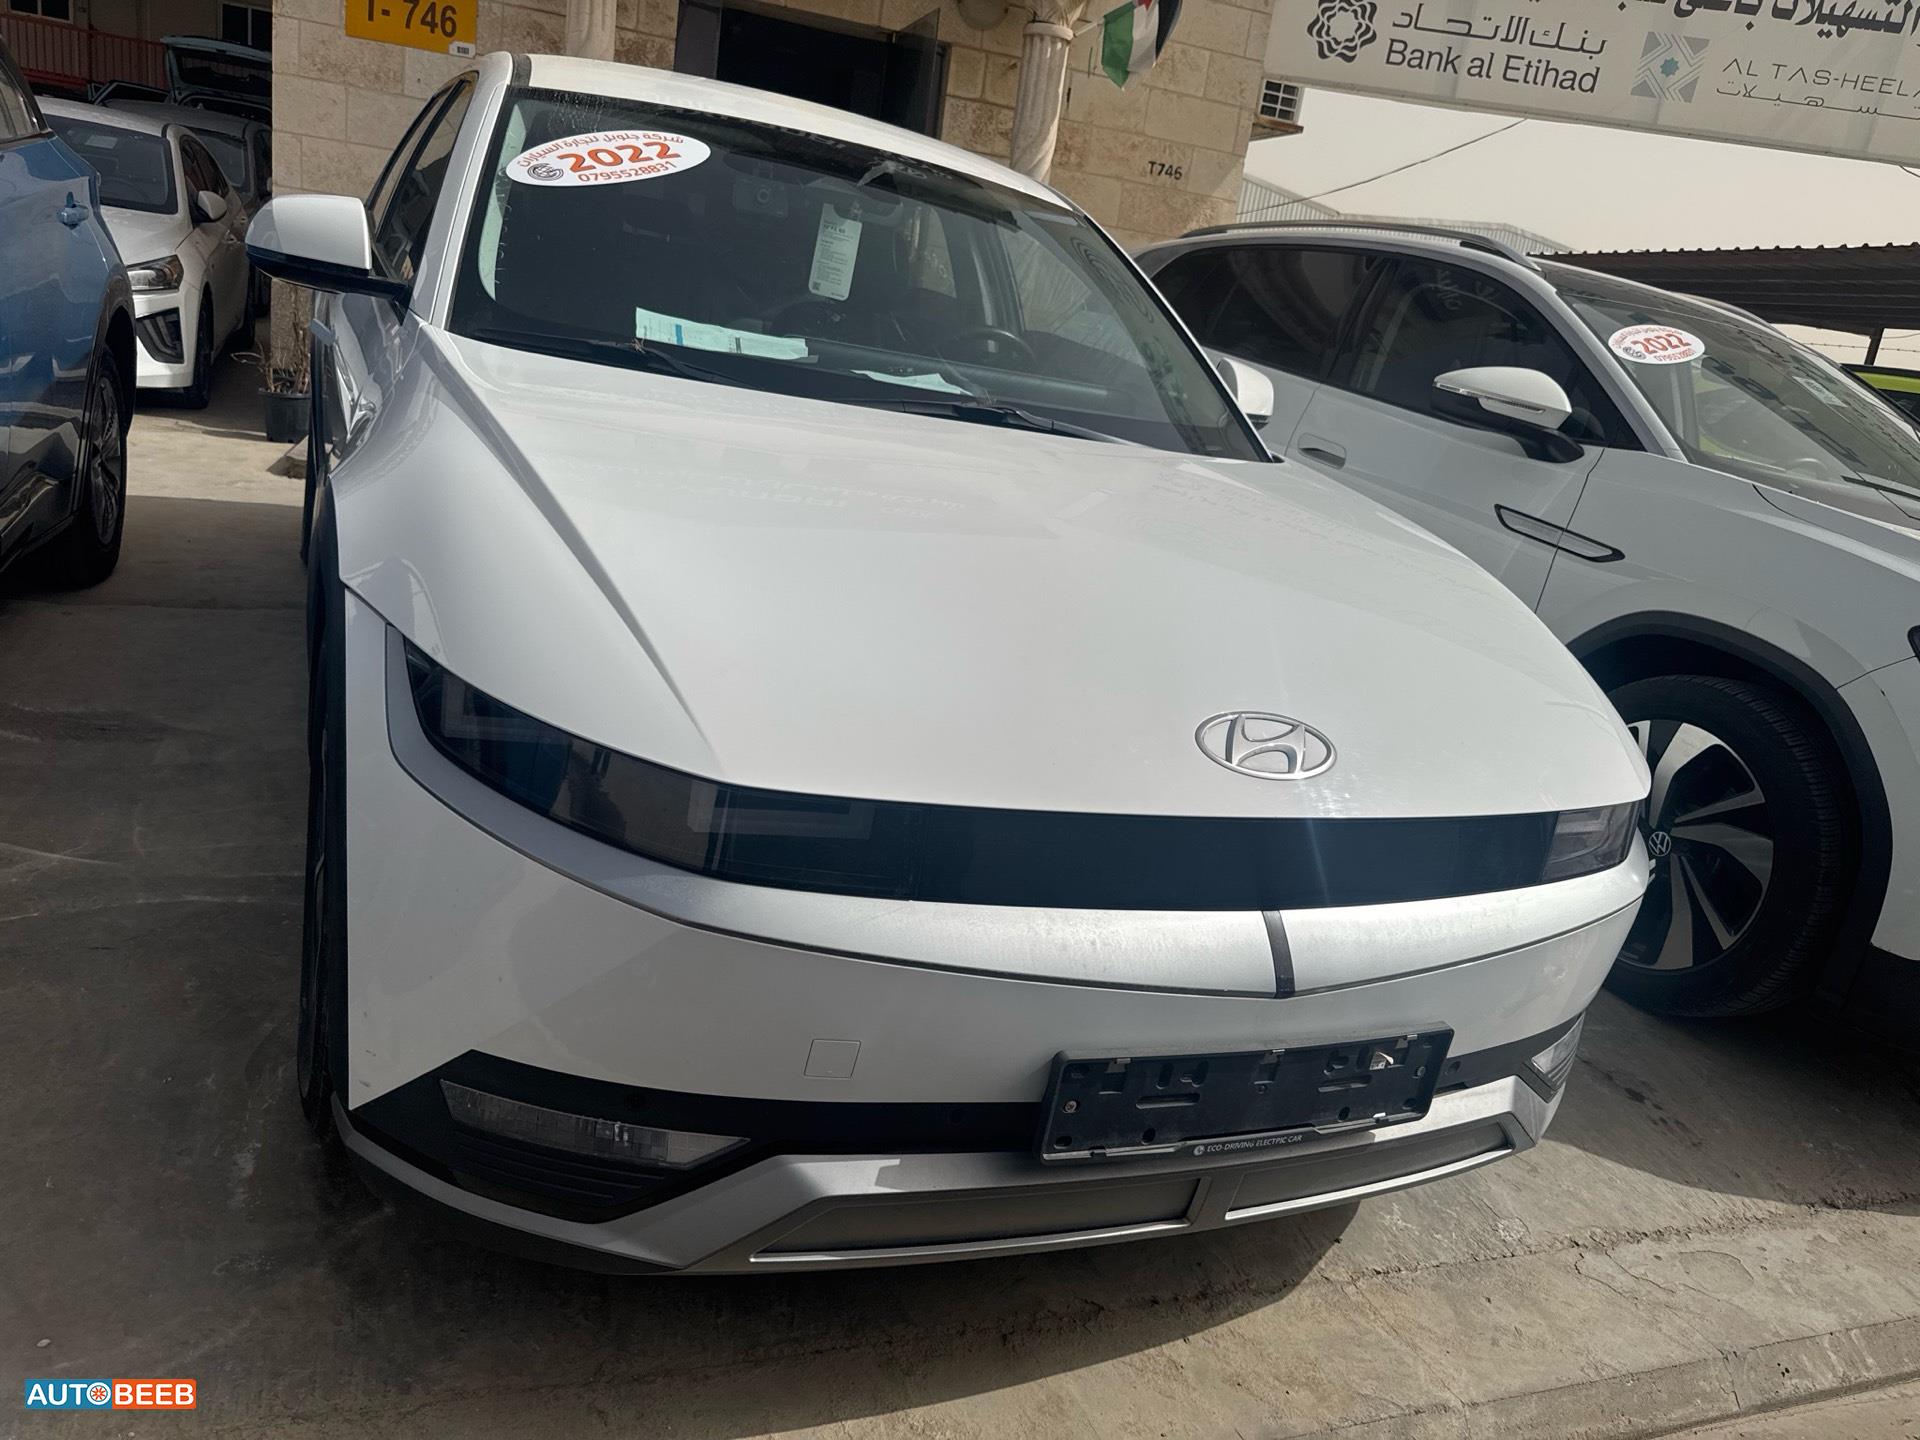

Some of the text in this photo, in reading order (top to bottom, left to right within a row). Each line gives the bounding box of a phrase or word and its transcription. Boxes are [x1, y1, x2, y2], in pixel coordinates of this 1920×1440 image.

[402, 0, 457, 38] 746
[1392, 3, 1607, 60] بنك الاتحاد
[1385, 38, 1600, 94] Bank al Etihad
[1722, 58, 1759, 78] AL
[557, 141, 682, 173] 2022
[577, 161, 677, 183] 0795528831
[1148, 160, 1183, 181] T746
[1631, 333, 1692, 355] 2022
[1287, 1134, 1303, 1143] CAR
